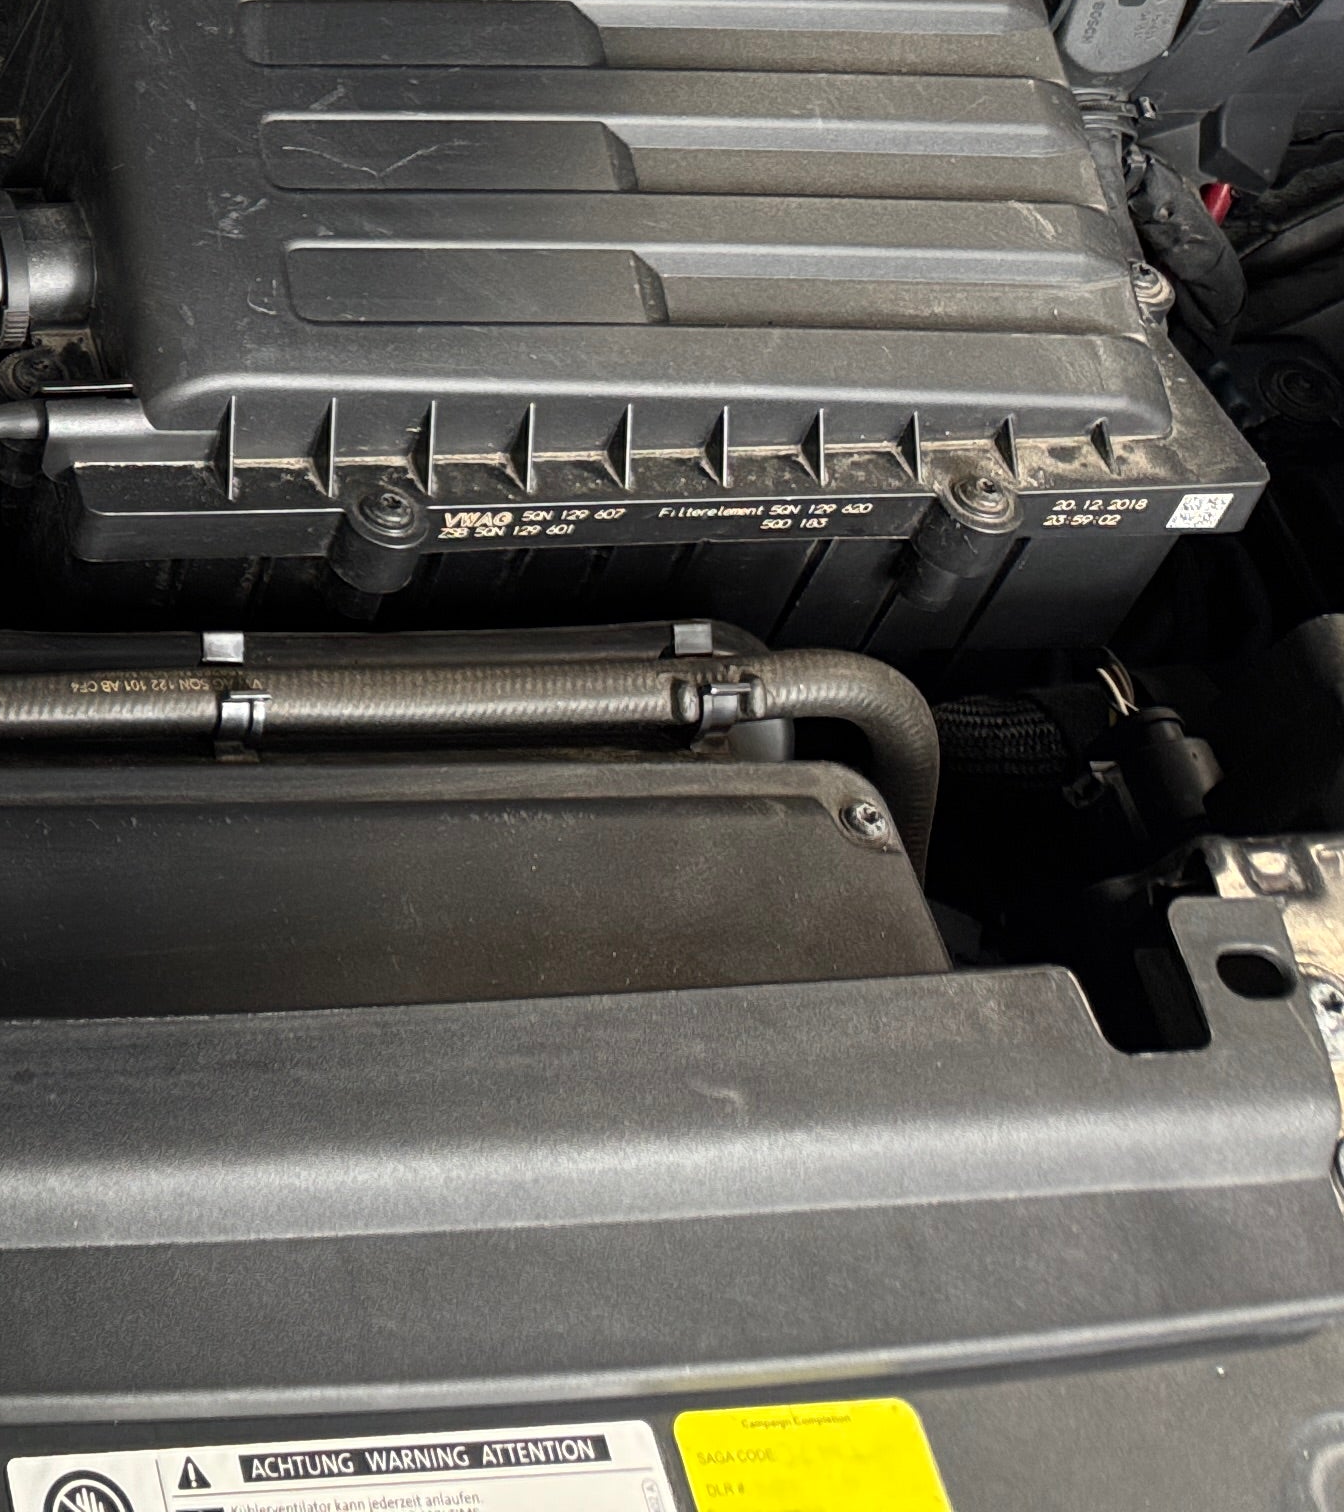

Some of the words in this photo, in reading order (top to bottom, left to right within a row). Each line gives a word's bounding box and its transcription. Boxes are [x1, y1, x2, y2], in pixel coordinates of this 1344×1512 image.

[560, 509, 590, 521] 129
[593, 507, 628, 520] 607
[658, 505, 764, 518] Filterelement
[808, 503, 838, 515] 129
[841, 502, 874, 514] 620
[799, 517, 830, 529] 183
[1042, 514, 1122, 526] 23:59:02
[512, 524, 542, 536] 129
[545, 523, 576, 535] 601
[100, 680, 120, 693] AB
[123, 679, 147, 692] 101
[150, 679, 175, 692] 122
[250, 1451, 355, 1479] ACHTUNG
[365, 1445, 471, 1473] WARNING
[481, 1437, 596, 1466] ATTENTION
[696, 1449, 735, 1466] SAGA
[736, 1447, 777, 1464] CODE
[334, 1498, 365, 1512] kann
[368, 1495, 422, 1512] jederzeit
